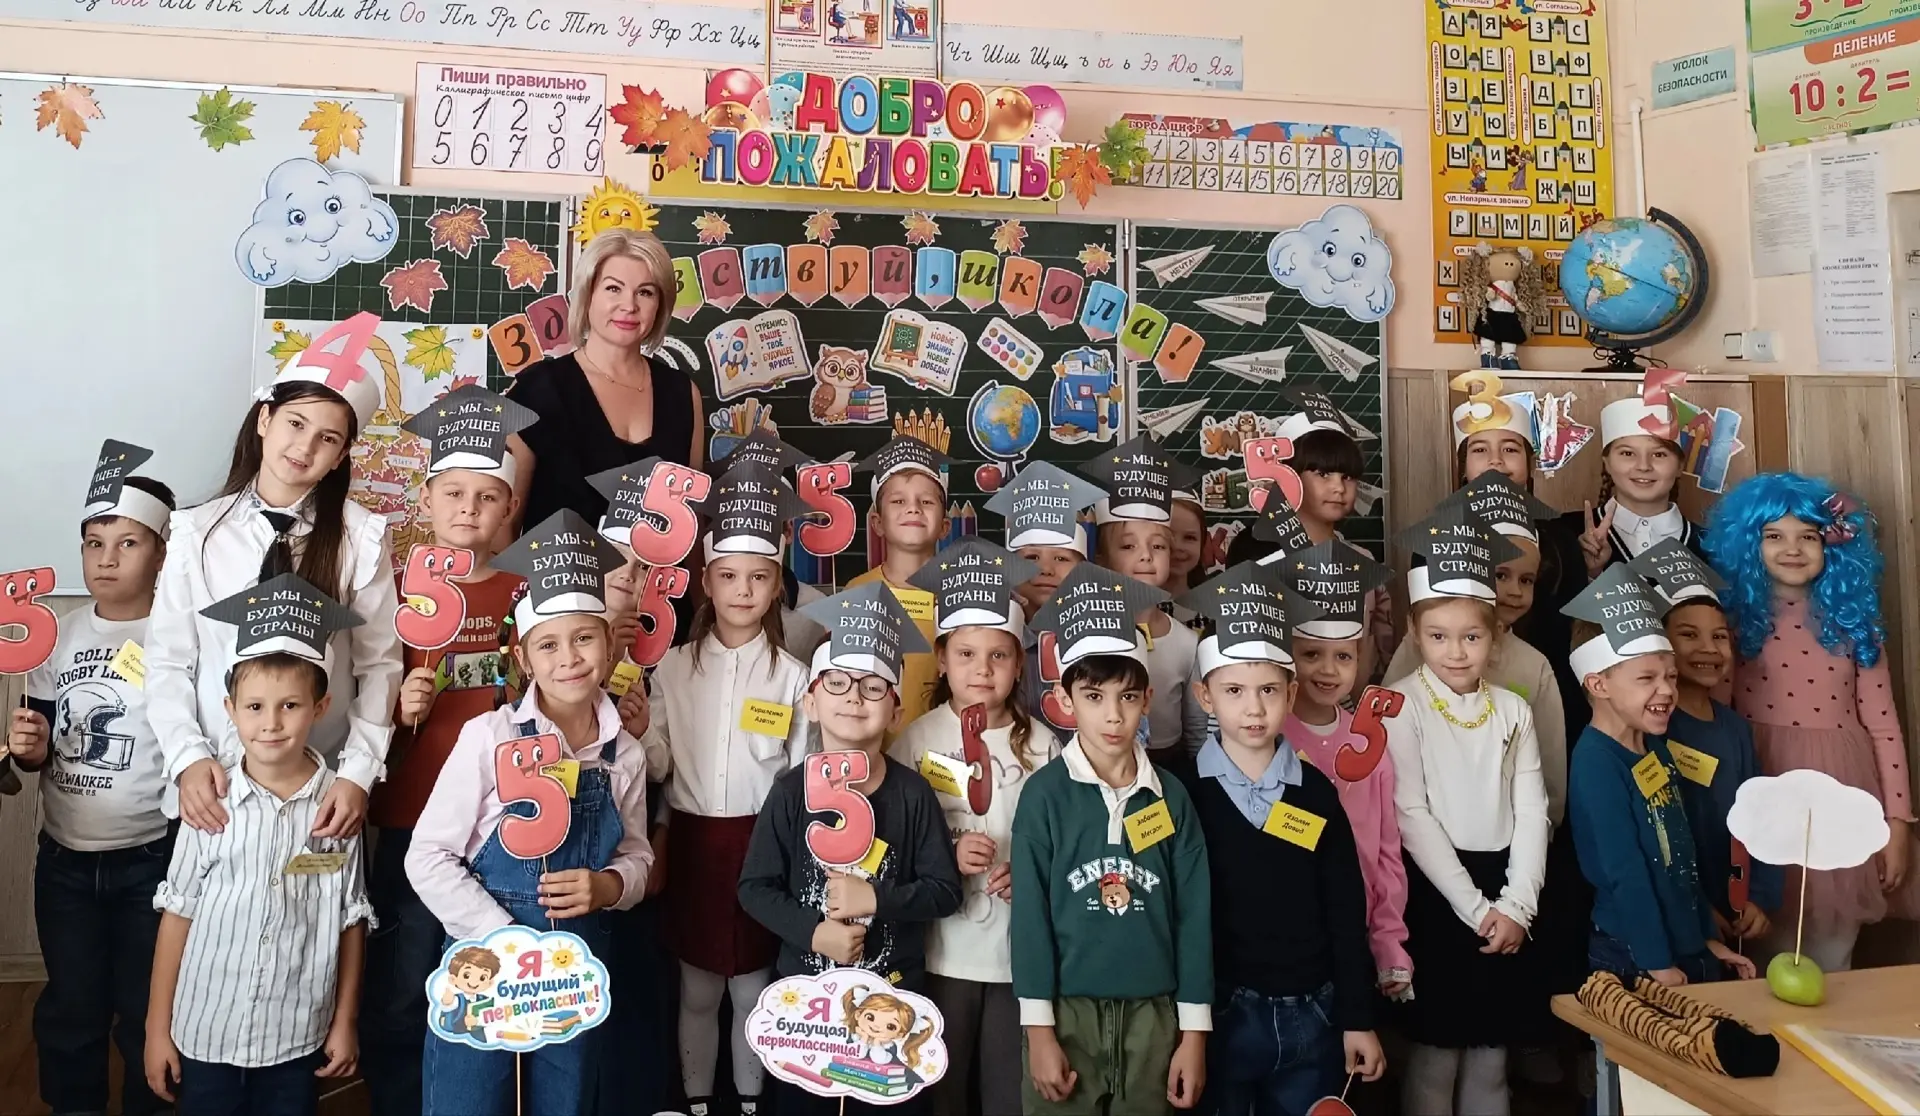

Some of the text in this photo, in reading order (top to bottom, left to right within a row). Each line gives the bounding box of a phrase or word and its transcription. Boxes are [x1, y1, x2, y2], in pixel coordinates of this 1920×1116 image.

[440, 4, 477, 26] Пп
[486, 6, 516, 37] Рр
[526, 9, 550, 31] Сс
[560, 12, 608, 35] Тт
[617, 16, 642, 48] Уу
[649, 18, 681, 48] Фф
[688, 22, 722, 43] Хх
[730, 25, 760, 48] Цц
[1804, 19, 1857, 36] ПРОИЗВЕДЕНИЕ
[1832, 29, 1896, 58] ДЕЛЕНИЕ
[982, 43, 1021, 64] Шш
[1030, 46, 1069, 69] Щщ
[1140, 52, 1159, 71] Ээ
[1167, 53, 1198, 74] Юю
[1206, 55, 1234, 76] Яя
[1672, 55, 1709, 73] УГОЛОК
[440, 67, 587, 92] Пиши правильно
[1657, 69, 1729, 94] БЕЗОПАСНОСТИ
[436, 84, 591, 103] Каллиграфическое письмо цифр
[1789, 67, 1878, 115] 10 2
[434, 94, 603, 137] 0 1 2 3 4
[797, 74, 987, 139] ДОБРО
[1128, 120, 1203, 134] ГОРОД ЦИФР
[431, 131, 601, 172] 5 6 7 8 9
[702, 130, 1065, 200] ПОЖАЛОВАТЬ!
[1145, 162, 1398, 197] 11 12 13 14 15 16 17 18 19 20
[1169, 257, 1196, 277] МЕЧТА!
[754, 318, 788, 333] СТРЕМИСЬ
[930, 331, 955, 346] НОВЫЕ
[296, 311, 382, 392] 4
[762, 346, 795, 362] БУДУЩЕЕ
[926, 351, 950, 364] НОВЫЕ
[768, 357, 795, 371] ЯРКОЕ!
[920, 361, 950, 377] ПОБЕДЫ!
[1327, 350, 1350, 374] УСПЕХ!
[458, 403, 482, 415] МЫ
[437, 418, 501, 436] БУДУЩЕЕ
[439, 436, 492, 452] СТРАНЫ
[1132, 454, 1154, 466] МЫ
[737, 481, 761, 494] МЫ
[1027, 479, 1049, 492] МЫ
[1113, 470, 1169, 487] БУДУЩЕЕ
[1117, 486, 1165, 502] СТРАНЫ
[1486, 484, 1509, 495] МЫ
[629, 461, 711, 566] 5
[718, 499, 778, 517] БУДУЩЕЕ
[796, 461, 856, 557] 5
[1013, 496, 1070, 513] БУДУЩЕЕ
[720, 518, 772, 533] СТРАНЫ
[1015, 512, 1065, 528] СТРАНЫ
[554, 531, 581, 547] МЫ
[1453, 525, 1476, 538] МЫ
[958, 554, 980, 567] МЫ
[1431, 541, 1491, 562] БУДУЩЕЕ
[532, 550, 599, 573] БУДУЩЕЕ
[1320, 562, 1343, 575] МЫ
[1439, 560, 1489, 579] СТРАНЫ
[540, 571, 599, 590] СТРАНЫ
[941, 572, 1003, 591] БУДУЩЕЕ
[1073, 582, 1099, 596] МЫ
[1241, 582, 1267, 597] МЫ
[1297, 579, 1360, 595] БУДУЩЕЕ
[1616, 582, 1640, 595] МЫ
[272, 590, 301, 602] МЫ
[393, 543, 475, 650] 5
[944, 590, 997, 607] СТРАНЫ
[246, 604, 322, 625] БУДУЩЕЕ
[864, 599, 887, 617] МЫ
[1058, 599, 1126, 626] БУДУЩЕЕ
[1220, 602, 1286, 622] БУДУЩЕЕ
[250, 620, 315, 639] СТРАНЫ
[839, 615, 900, 647] БУДУЩЕЕ
[1063, 617, 1121, 641] СТРАНЫ
[1228, 621, 1284, 640] СТРАНЫ
[842, 634, 895, 661] СТРАНЫ
[1334, 684, 1405, 783] 5
[494, 733, 572, 859] 5
[804, 750, 876, 867] 5
[1066, 856, 1161, 894] ENERGY
[516, 950, 542, 979] Я
[497, 974, 580, 1000] будущий
[482, 984, 600, 1024] первоклассник!
[804, 997, 831, 1022] Я
[776, 1017, 848, 1039] будущая
[757, 1034, 861, 1058] первоклассница!
